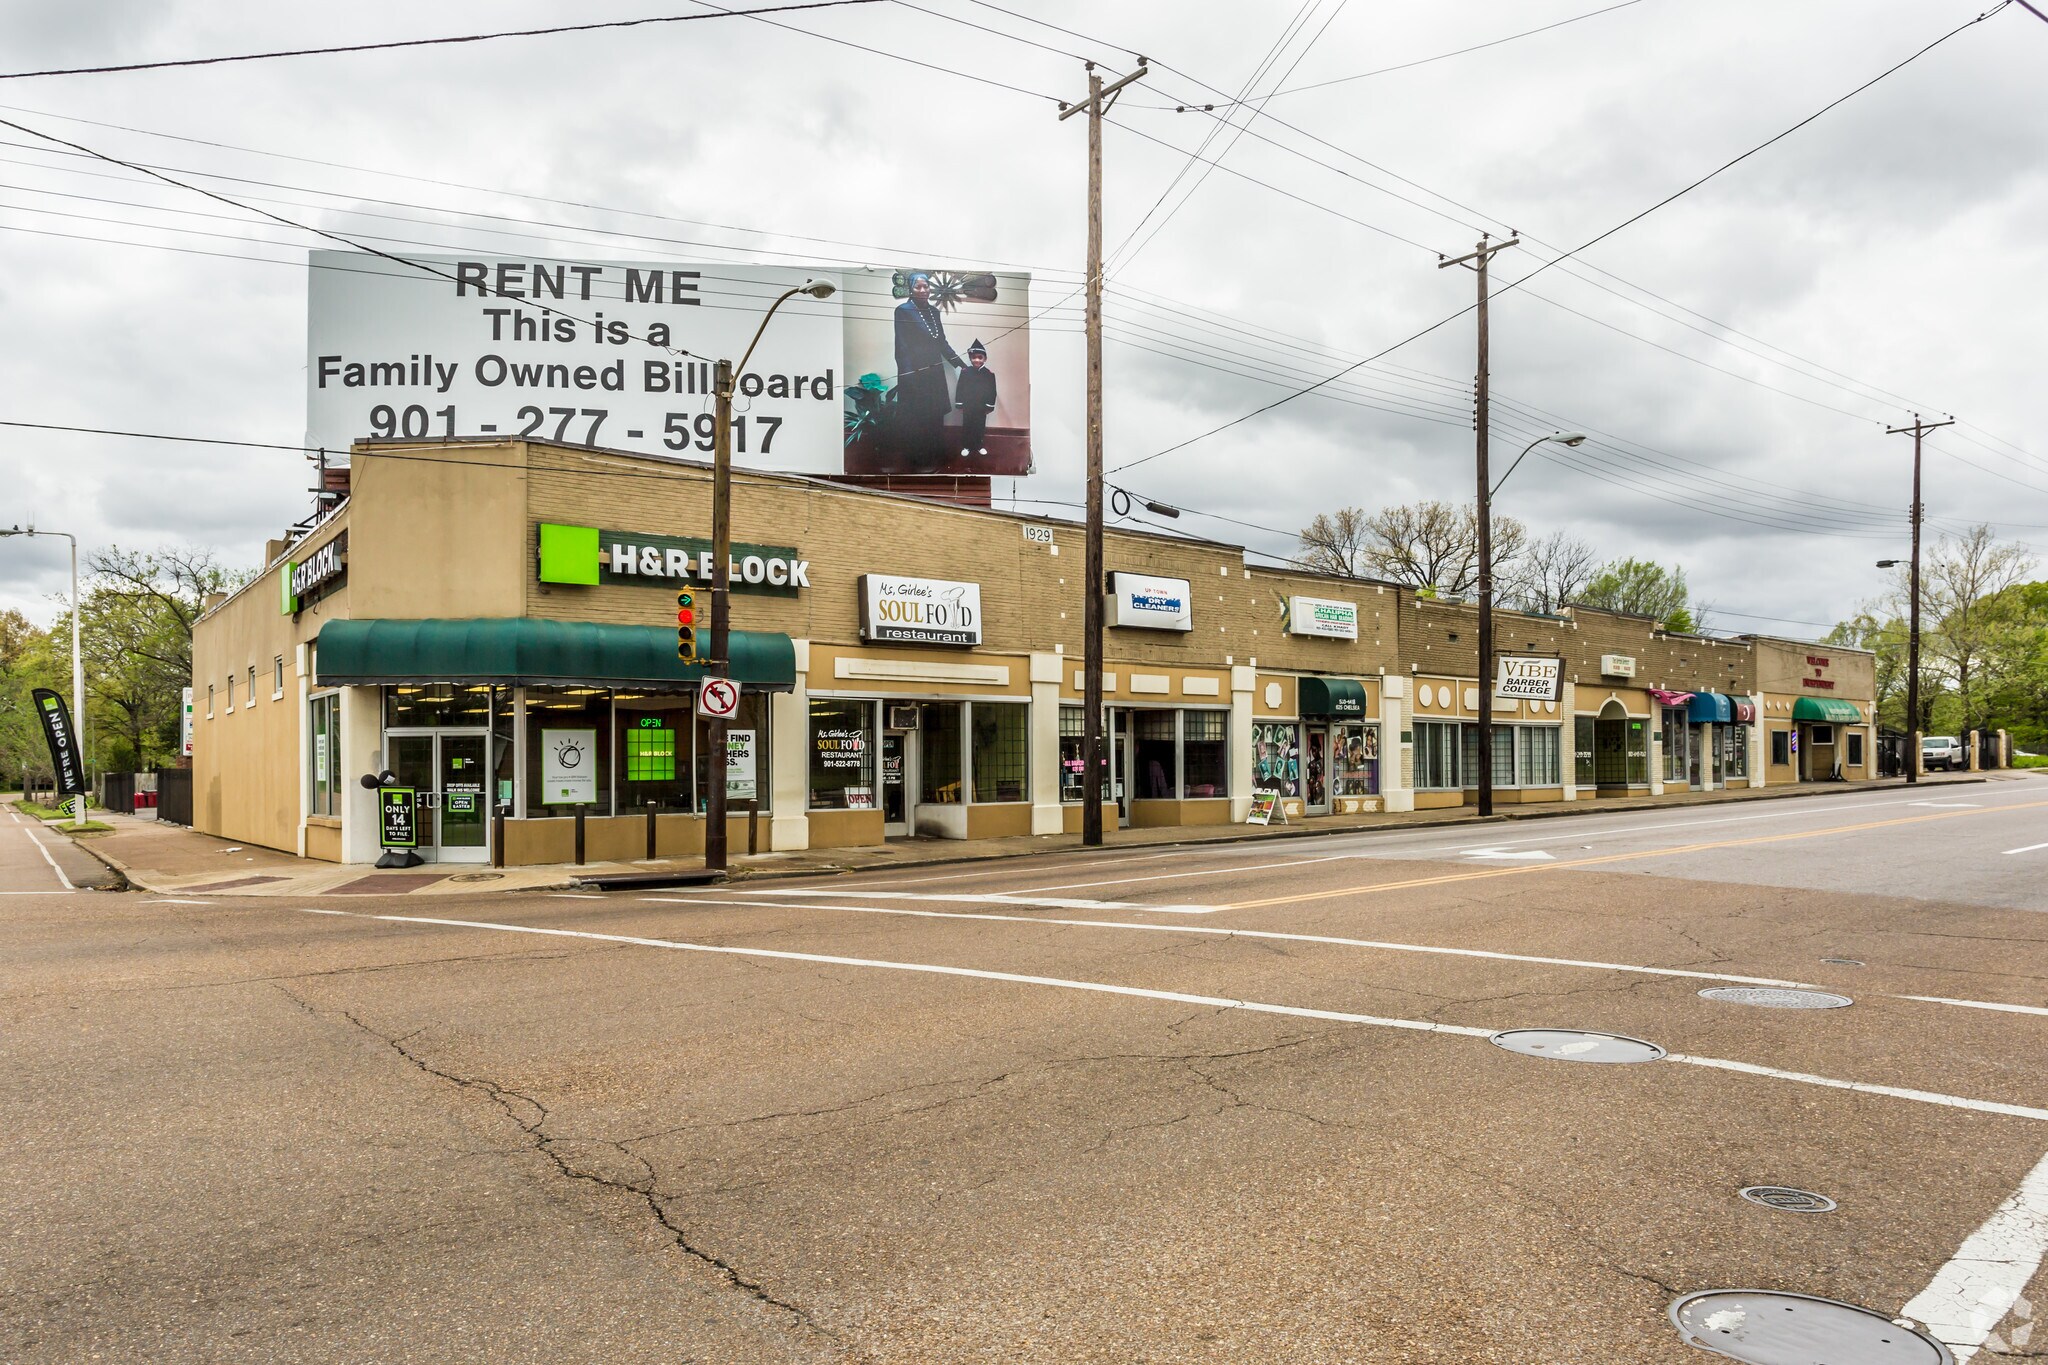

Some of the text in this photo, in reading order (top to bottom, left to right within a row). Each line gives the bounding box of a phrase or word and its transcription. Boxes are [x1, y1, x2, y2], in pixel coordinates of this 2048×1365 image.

[456, 262, 701, 305] RENT ME
[483, 309, 671, 346] This is a
[318, 355, 834, 400] Family Owned Billoard
[369, 404, 456, 438] 901
[516, 405, 608, 446] 277
[663, 412, 783, 454] 5917
[1026, 527, 1051, 542] 1929
[307, 541, 336, 587] BLOCK
[611, 543, 811, 588] H&R BLOCK
[897, 583, 933, 598] Girlee's
[1133, 602, 1180, 612] CLEANERS
[1148, 597, 1167, 605] DRY
[879, 599, 972, 629] SOUL FOD
[886, 629, 968, 643] restaurant
[1503, 660, 1557, 679] VIBE
[1506, 678, 1550, 687] BARBER
[1502, 685, 1552, 695] COLLEGE
[48, 711, 67, 748] OPEN
[640, 718, 662, 728] OPEN
[730, 734, 751, 742] FIND
[727, 742, 746, 750] NEY
[817, 739, 866, 751] SOUL FOD
[727, 750, 750, 758] HERS
[821, 751, 862, 759] RESTAURANT
[59, 750, 76, 790] WE'RE
[848, 794, 872, 804] OPEN
[385, 805, 411, 814] ONLY
[391, 813, 406, 826] 14
